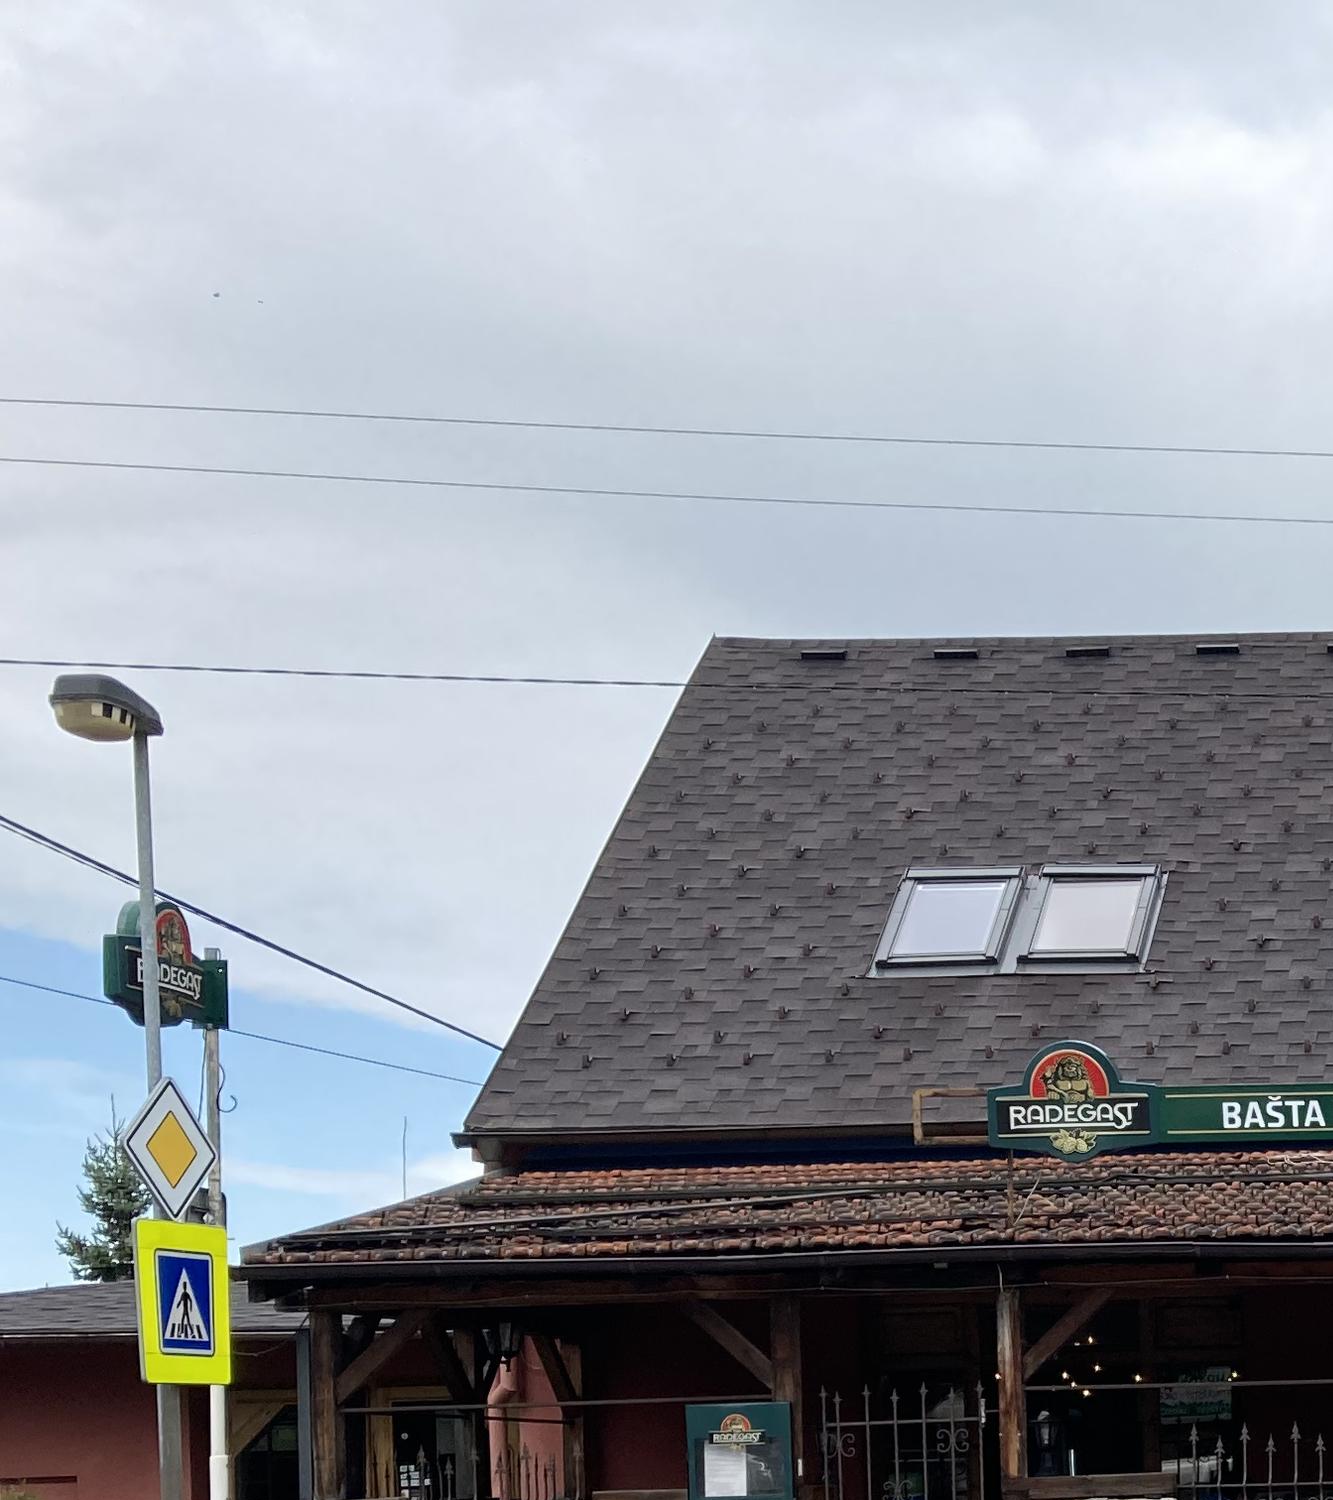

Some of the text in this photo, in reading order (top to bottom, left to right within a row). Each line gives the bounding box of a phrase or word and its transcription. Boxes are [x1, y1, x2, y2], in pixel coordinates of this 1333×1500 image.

[137, 957, 202, 1000] RDEGAST
[1009, 1101, 1139, 1130] RADEGAST
[1222, 1096, 1326, 1129] BAŠTA
